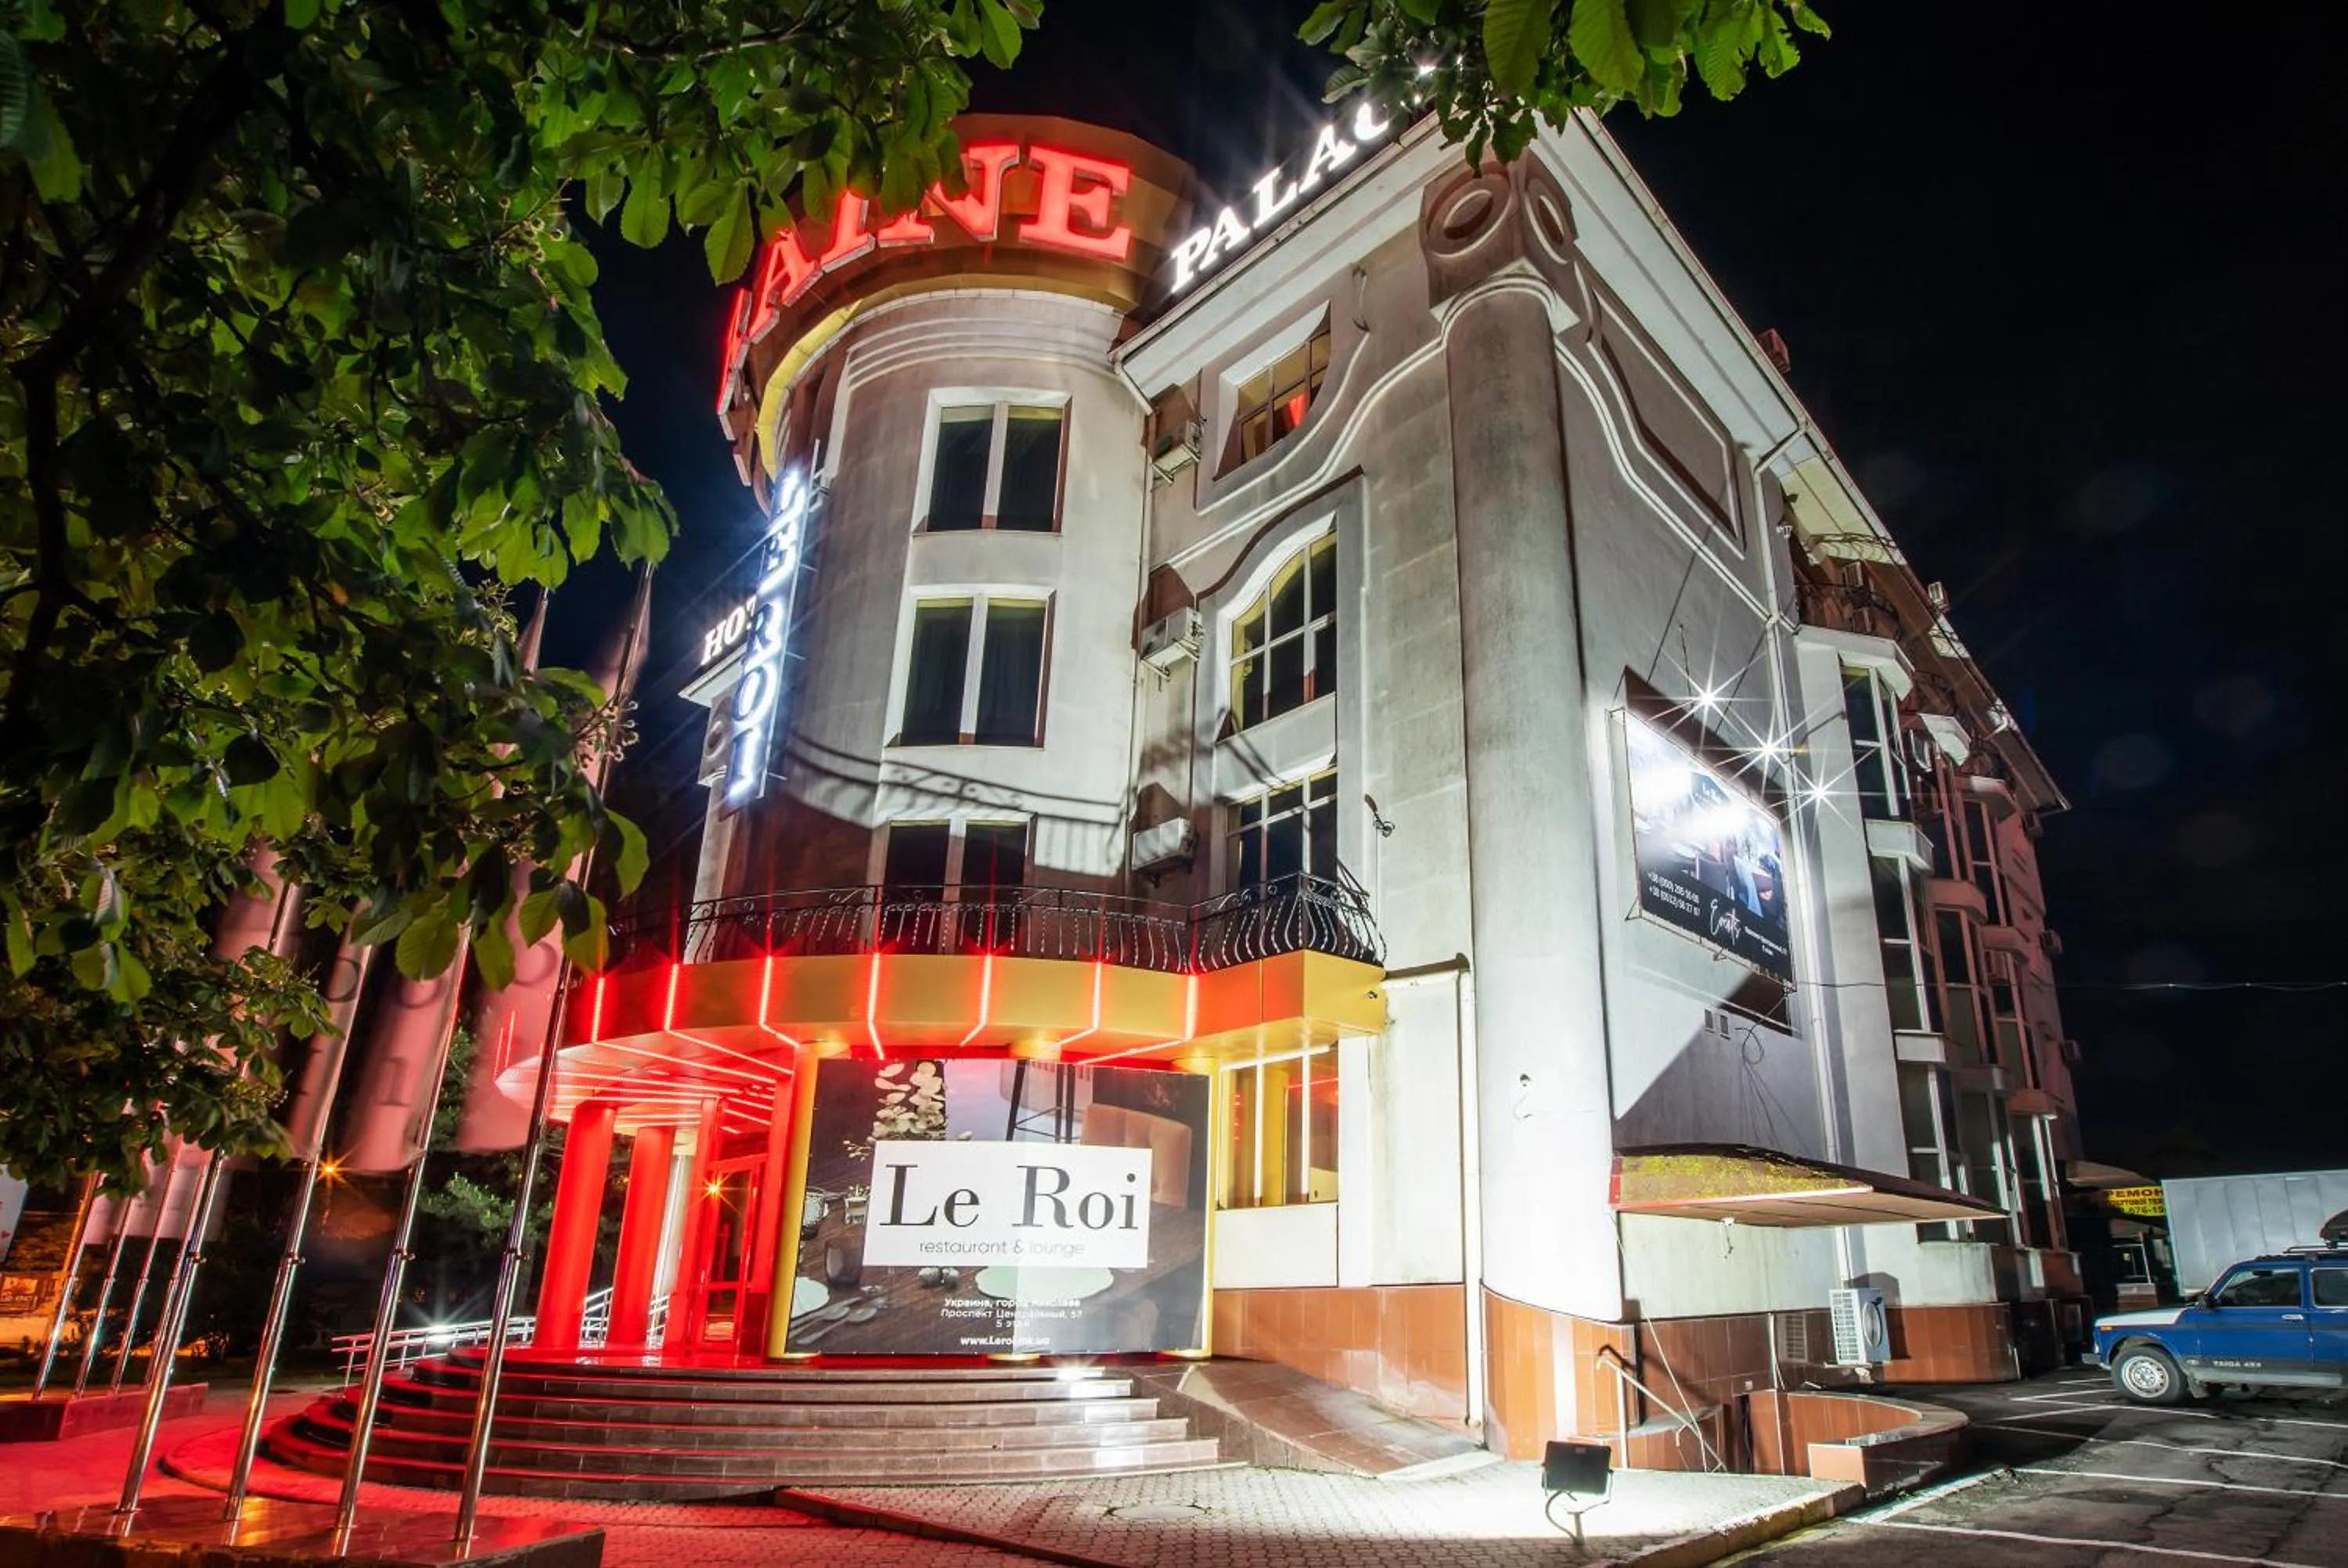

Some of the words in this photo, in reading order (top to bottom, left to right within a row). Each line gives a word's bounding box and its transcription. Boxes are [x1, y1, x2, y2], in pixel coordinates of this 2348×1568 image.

[1170, 88, 1409, 294] PALAC
[880, 1164, 979, 1227] Le
[1013, 1166, 1137, 1229] Roi
[2104, 1189, 2165, 1198] РЕМОН
[919, 1239, 1007, 1254] restaurant
[1013, 1239, 1025, 1255] &
[1029, 1239, 1086, 1257] lounge
[944, 1298, 994, 1308] Украина,
[940, 1308, 992, 1319] Проспект
